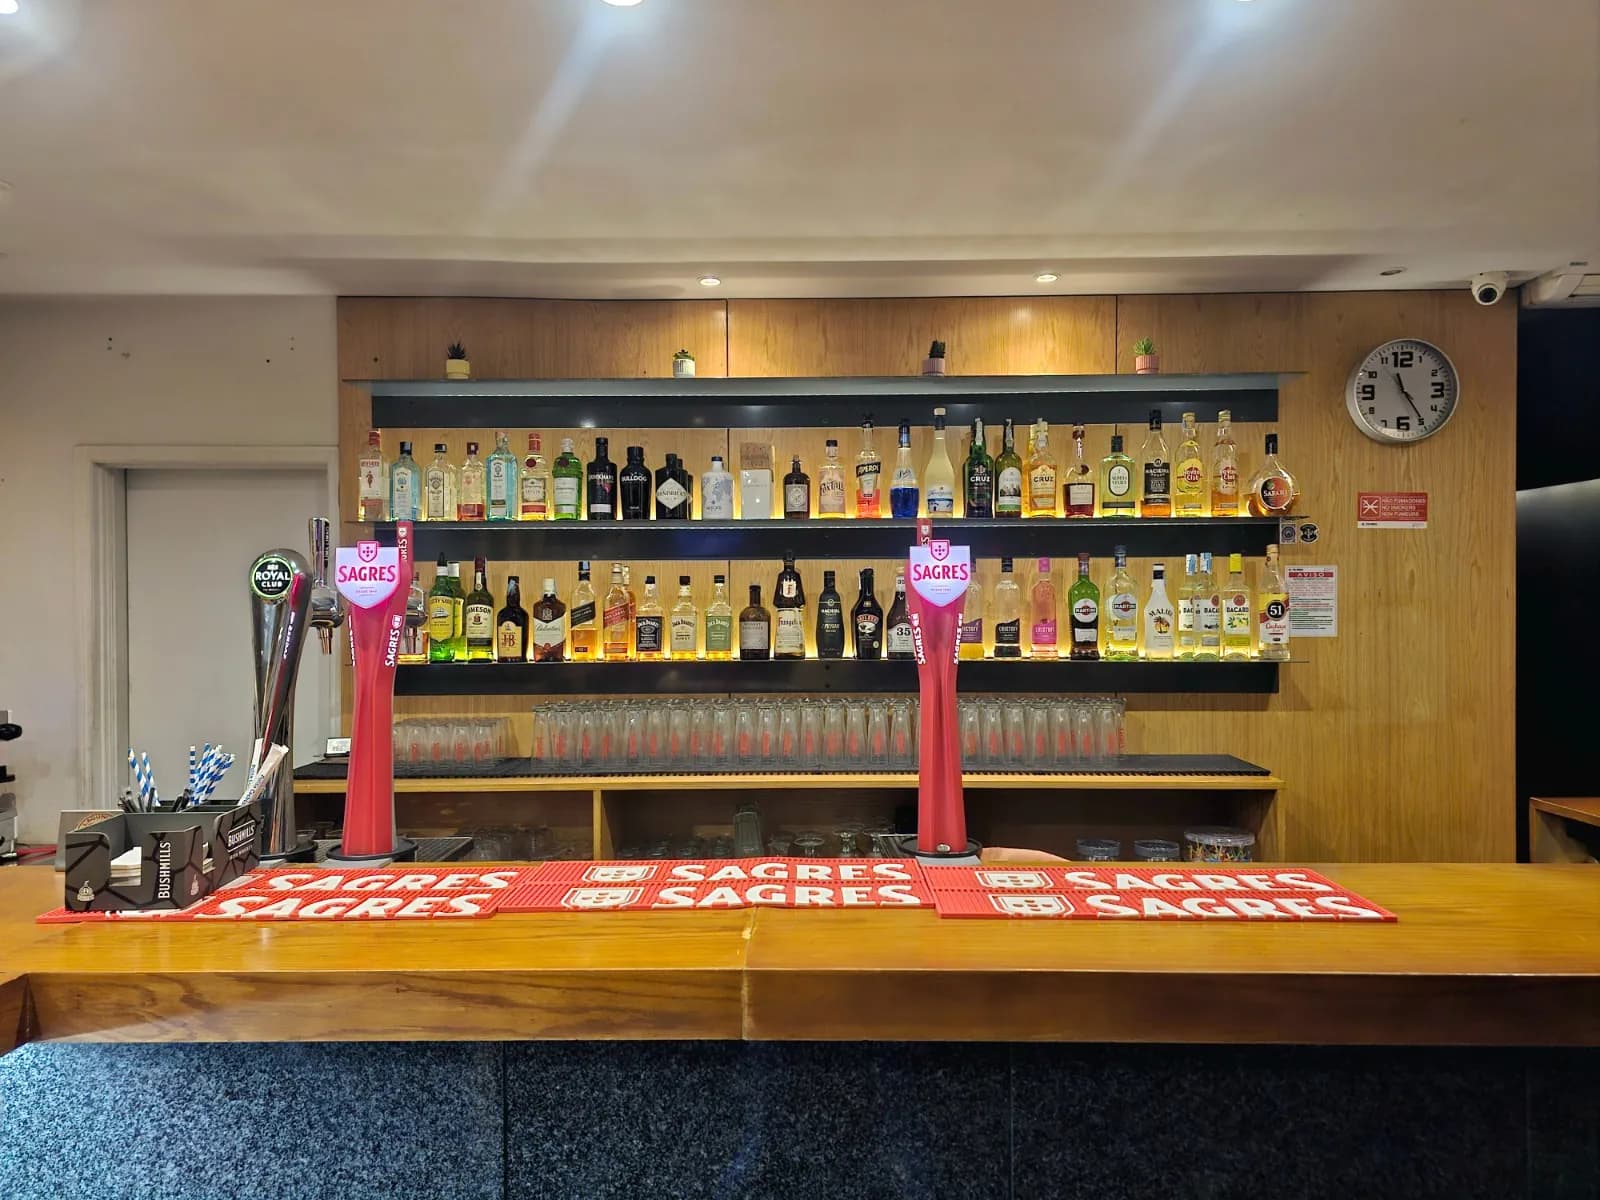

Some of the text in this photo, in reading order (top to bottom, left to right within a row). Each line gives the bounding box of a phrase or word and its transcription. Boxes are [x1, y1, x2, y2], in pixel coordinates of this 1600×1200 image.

[1380, 356, 1388, 365] 11
[1392, 351, 1414, 368] 12
[1367, 370, 1378, 380] 10
[1431, 368, 1439, 378] 2
[1361, 384, 1376, 401] 9
[1430, 382, 1445, 399] 3
[1368, 406, 1375, 415] 8
[1430, 404, 1438, 413] 4
[1380, 419, 1388, 429] 7
[1396, 416, 1411, 432] 6
[1417, 418, 1425, 427] 5
[621, 473, 648, 482] BULLDOG
[1032, 475, 1054, 483] CRUZ
[1263, 489, 1287, 498] SAFARI
[255, 571, 290, 581] ROYAL
[338, 565, 396, 583] SAGRES
[912, 563, 969, 581] SAGRES
[467, 606, 492, 614] JAMESON
[1270, 605, 1283, 615] 51
[896, 627, 911, 637] 35
[385, 629, 400, 668] SAGRES
[912, 626, 927, 665] SAGRES
[228, 825, 256, 848] BUSHMILLS
[158, 841, 172, 899] BUSHMILLS
[666, 861, 912, 882] SAGRES
[267, 871, 520, 891] SAGRES
[1062, 867, 1334, 891] SAGRES
[651, 884, 922, 909] SAGRES
[193, 893, 493, 919] SAGRES
[1084, 892, 1384, 921] SAGRES
